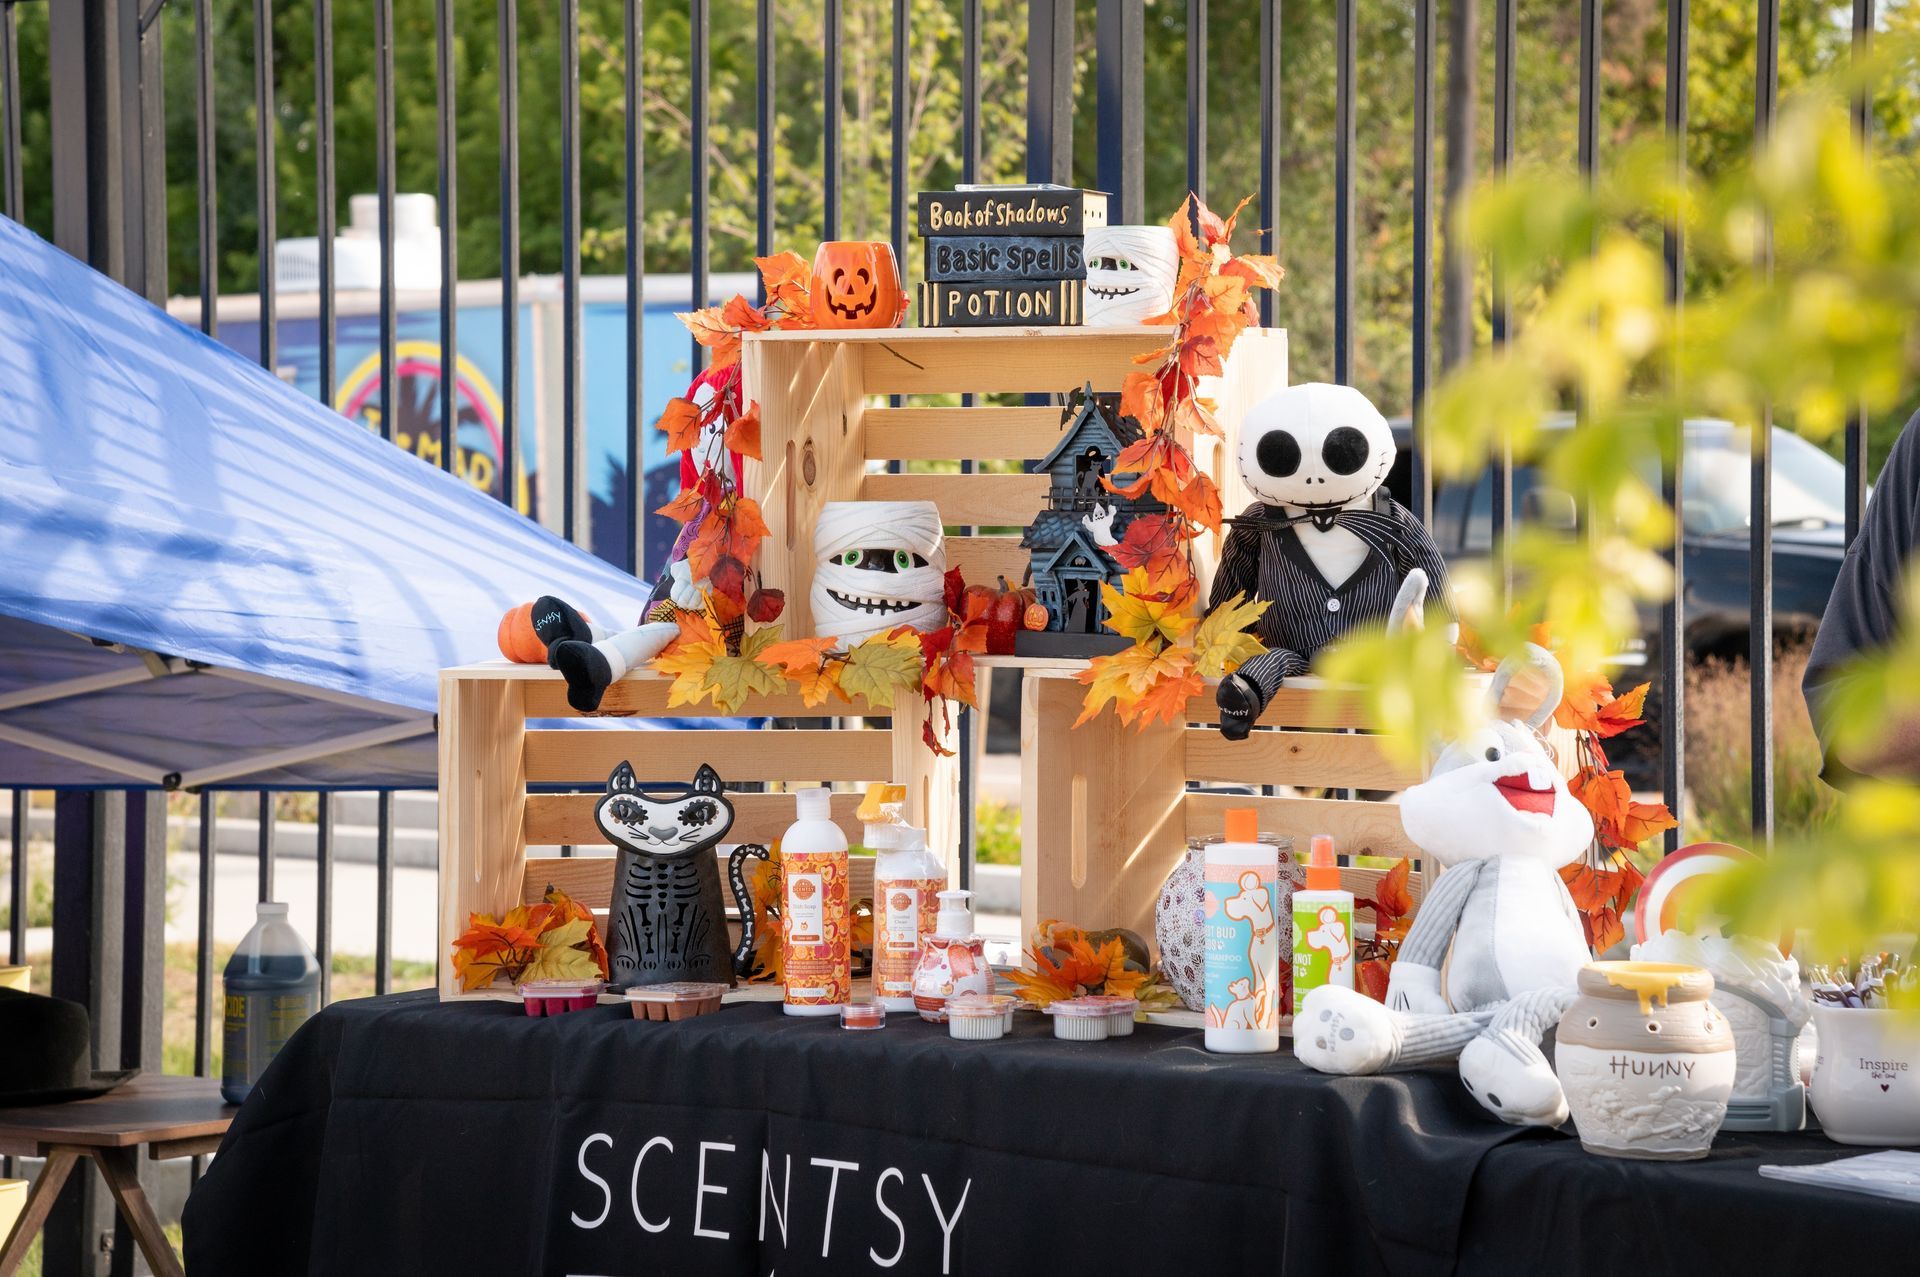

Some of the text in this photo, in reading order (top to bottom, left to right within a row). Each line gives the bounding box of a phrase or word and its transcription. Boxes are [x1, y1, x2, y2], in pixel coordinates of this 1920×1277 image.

[930, 198, 1070, 231] Book of Shadows
[937, 242, 1082, 274] Basic Spells
[948, 290, 1051, 317] POTION
[1216, 926, 1236, 938] BUD
[1609, 1055, 1696, 1080] HUNNY
[1859, 1057, 1909, 1073] Inspire
[571, 1132, 972, 1276] SCENTSY
